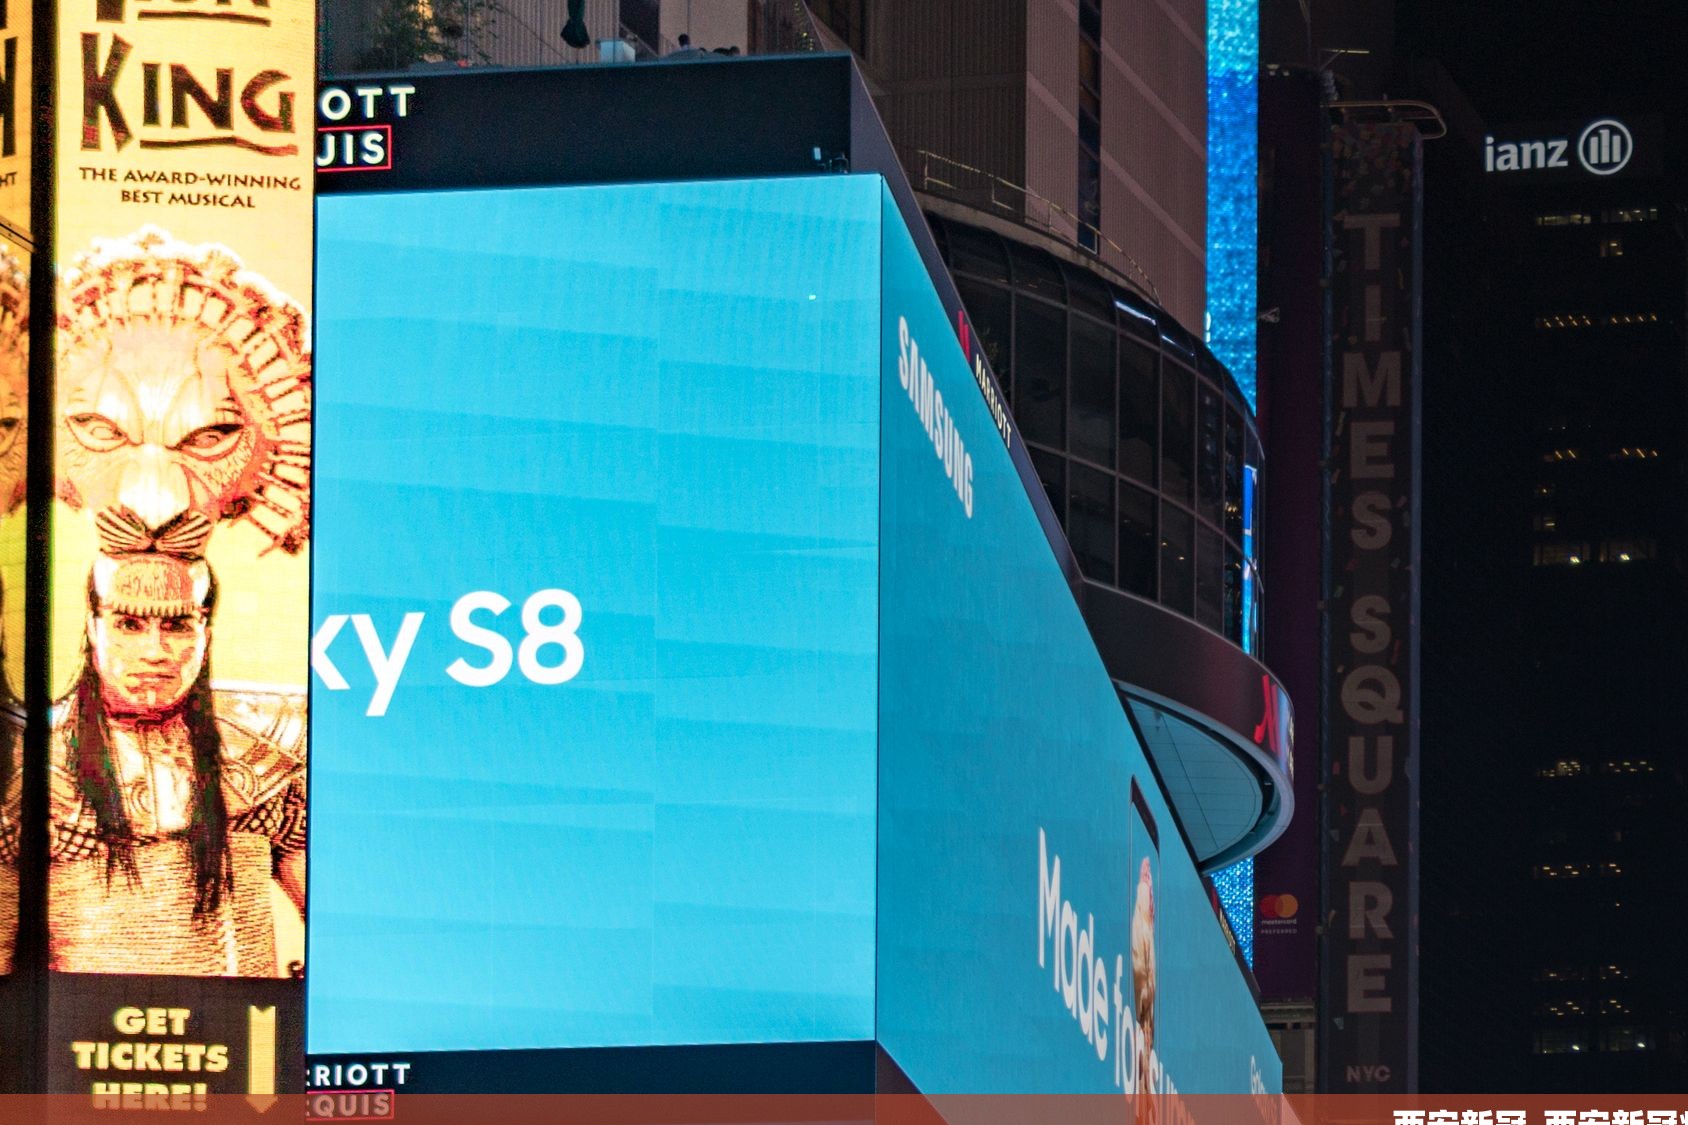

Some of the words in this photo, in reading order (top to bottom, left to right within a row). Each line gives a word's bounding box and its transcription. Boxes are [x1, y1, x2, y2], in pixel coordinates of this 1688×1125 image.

[80, 32, 296, 153] KING
[1485, 136, 1569, 172] ianz
[80, 167, 116, 182] THE
[124, 170, 301, 191] AWARD-WINNING
[120, 191, 163, 205] BEST
[167, 194, 256, 208] MUSICAL
[1342, 213, 1402, 550] TIMES
[976, 352, 1012, 448] MARRIOTT
[898, 315, 974, 519] SAMSUNG
[446, 588, 585, 688] S8
[1341, 594, 1404, 1013] SQUARE
[1039, 826, 1109, 1062] Made
[114, 1006, 190, 1035] GET
[72, 1042, 228, 1071] TICKETS
[306, 1064, 411, 1086] RIOTT
[1346, 1065, 1391, 1083] NYC
[92, 1083, 207, 1113] HERE!
[307, 1094, 391, 1117] QUIS
